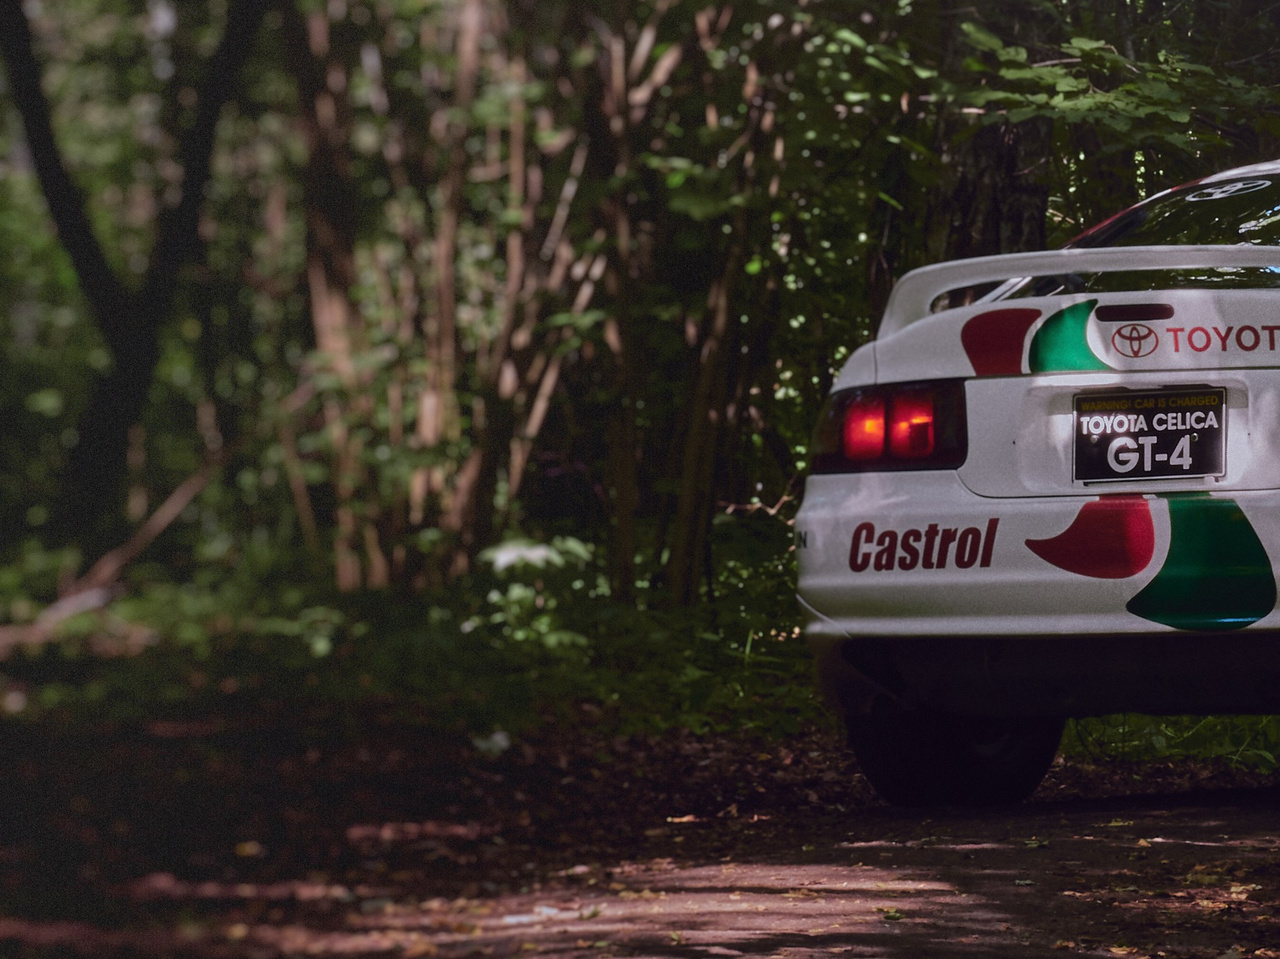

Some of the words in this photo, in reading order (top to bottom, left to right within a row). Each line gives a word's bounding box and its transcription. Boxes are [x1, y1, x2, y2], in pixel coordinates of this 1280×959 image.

[1081, 400, 1132, 411] WARNING!
[1134, 398, 1154, 409] CAR
[1157, 398, 1166, 408] IS
[1169, 395, 1219, 408] CHARGED
[1080, 414, 1148, 435] TOYOTA
[1152, 410, 1219, 432] CELICA
[1106, 434, 1192, 474] GT-4
[849, 518, 1000, 572] Castrol
